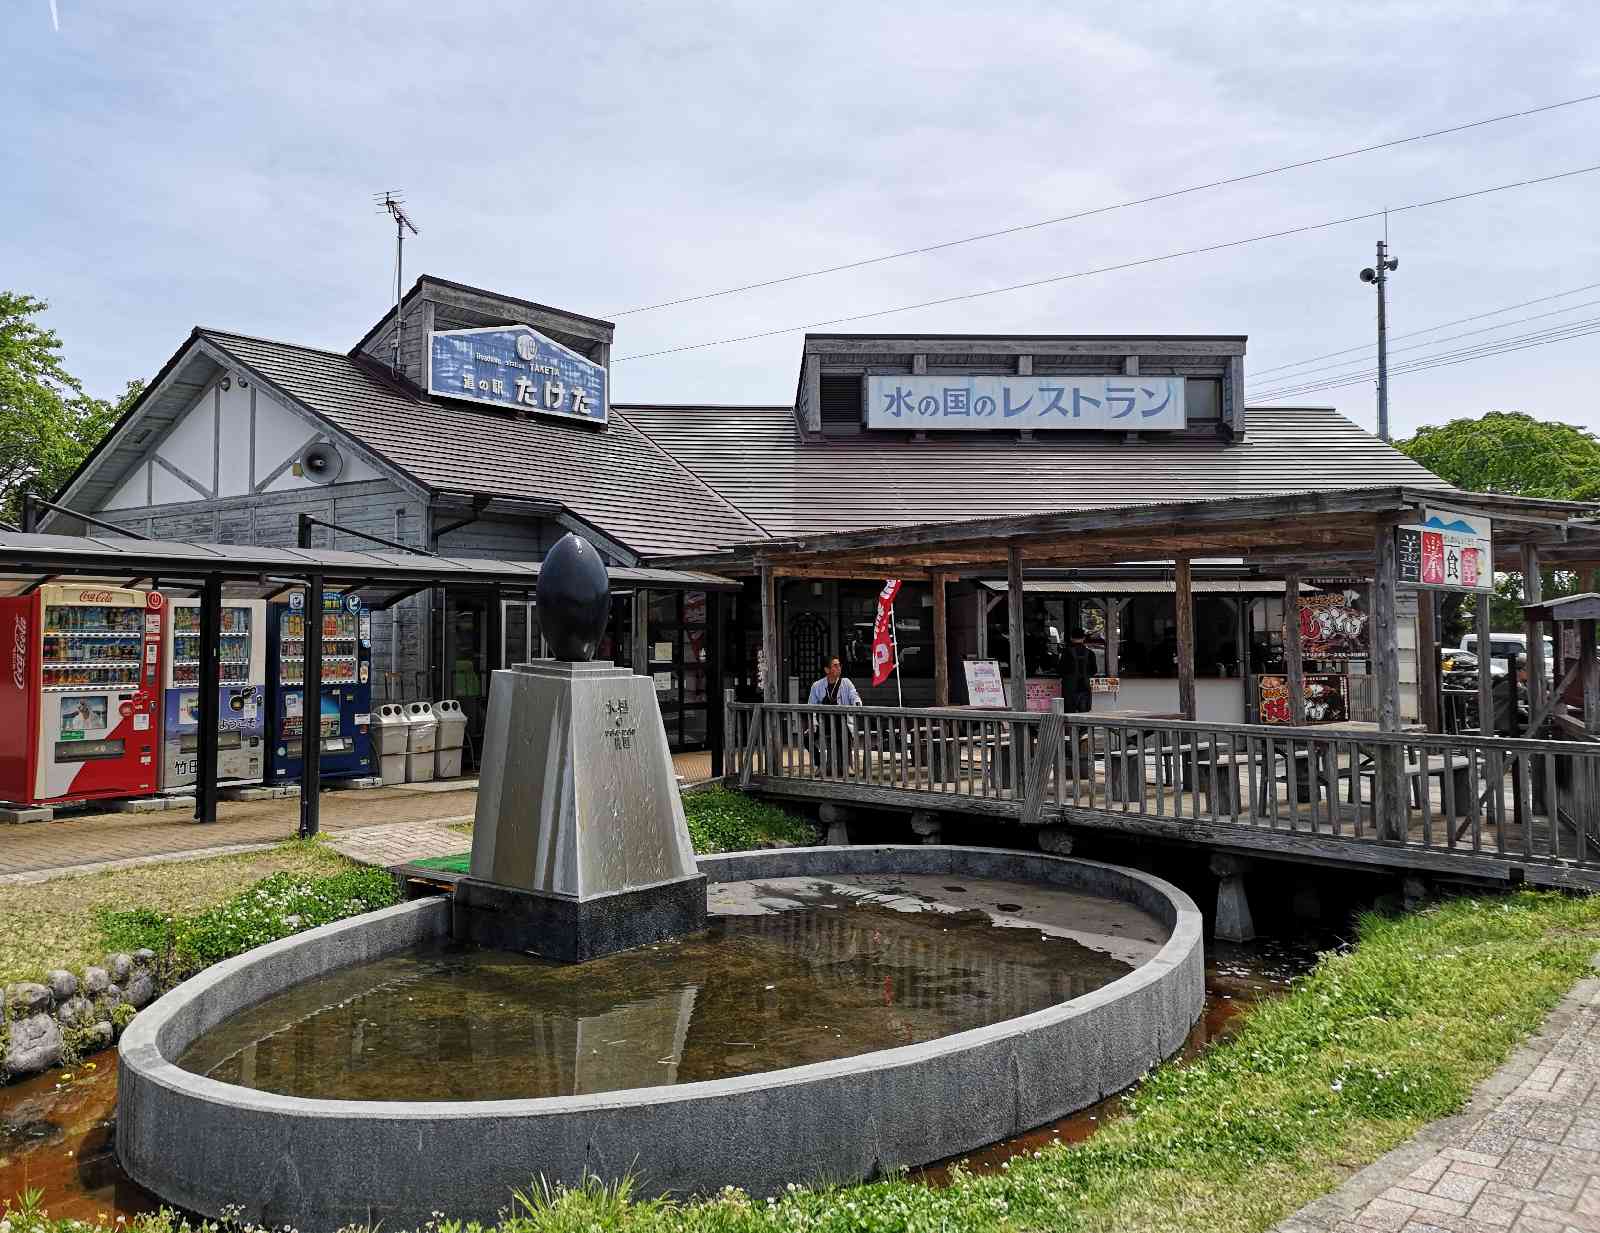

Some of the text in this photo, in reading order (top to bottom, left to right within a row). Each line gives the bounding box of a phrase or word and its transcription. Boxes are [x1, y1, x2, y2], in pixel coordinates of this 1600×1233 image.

[529, 363, 560, 377] TAKETA
[463, 373, 592, 415] 道の駅 たけた
[883, 386, 1171, 419] 水の国のレストラン
[218, 718, 256, 731] ようこそ
